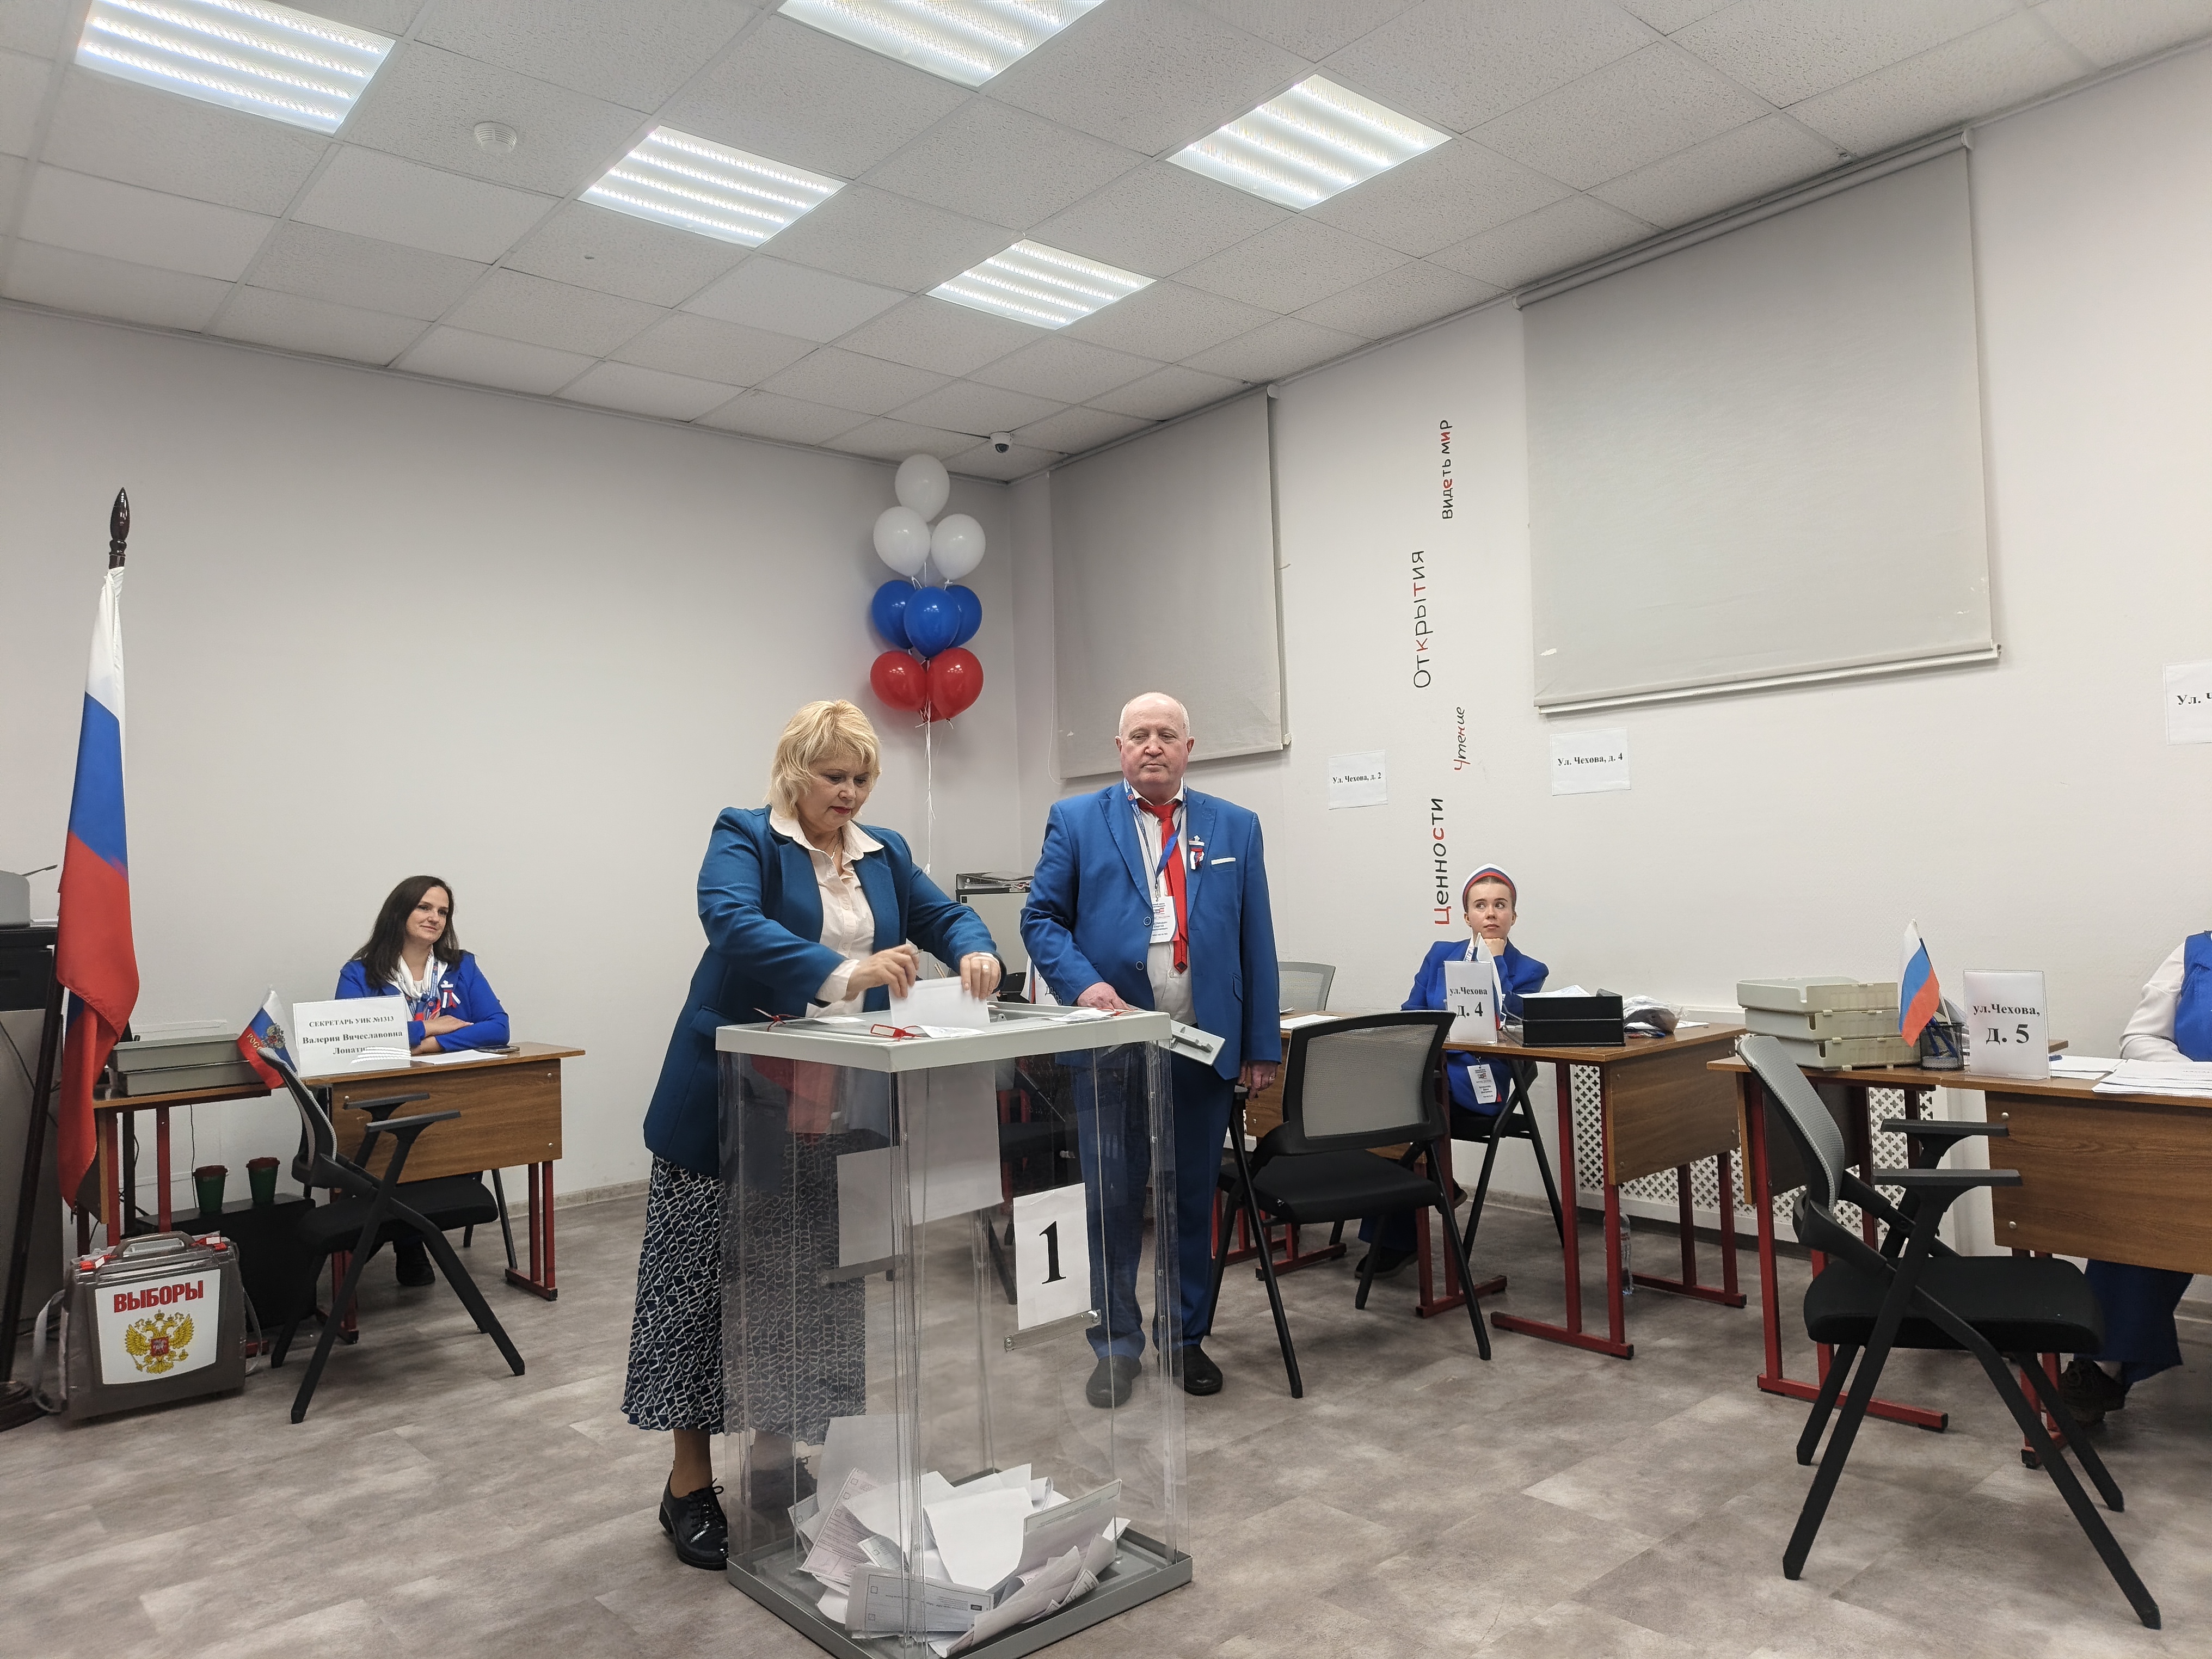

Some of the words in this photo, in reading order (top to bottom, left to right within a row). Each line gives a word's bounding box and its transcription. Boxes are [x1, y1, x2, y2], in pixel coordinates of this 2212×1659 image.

[1440, 420, 1453, 454] мир
[1412, 551, 1433, 688] Открытия
[2176, 694, 2202, 705] Ул.
[1453, 706, 1471, 770] Чтение
[1574, 756, 1607, 764] Чехова,
[1618, 752, 1623, 760] 4
[1431, 798, 1452, 925] Ценности
[1449, 987, 1488, 996] ул.Чехова
[1474, 1001, 1483, 1017] 4
[1973, 1003, 2040, 1017] ул.Чехова,
[309, 1019, 354, 1028] СЕКРЕТАРЬ
[303, 1036, 340, 1044] Валерия
[343, 1031, 403, 1041] Вячеславовна
[2016, 1024, 2030, 1044] 5
[1039, 1220, 1067, 1285] 1
[114, 1280, 204, 1313] ВЫБОРЫ
